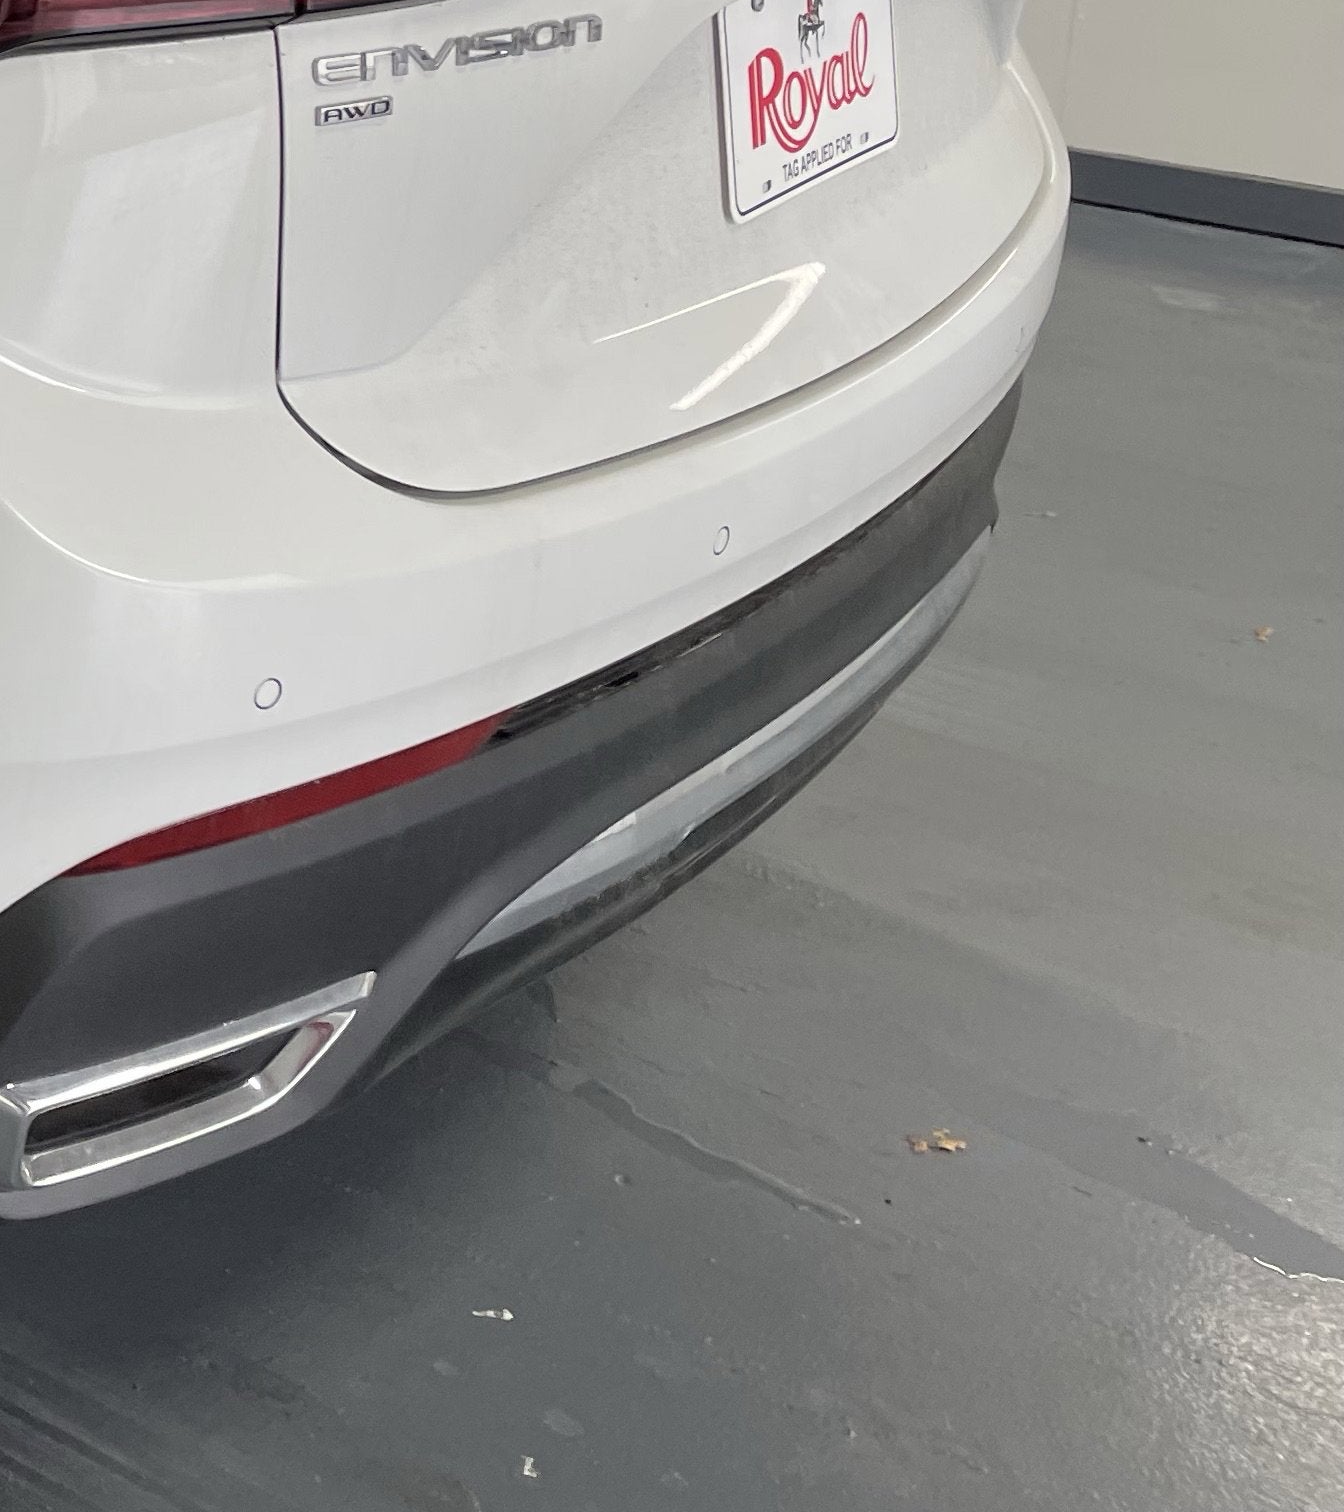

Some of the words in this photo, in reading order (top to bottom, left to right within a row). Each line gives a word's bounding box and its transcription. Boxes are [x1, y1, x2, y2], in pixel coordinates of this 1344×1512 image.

[312, 13, 603, 86] ENVISION
[323, 100, 391, 123] AWD
[748, 11, 875, 153] Royal
[782, 159, 799, 182] TAG
[801, 142, 834, 174] APPLIED
[836, 133, 853, 156] FOR
